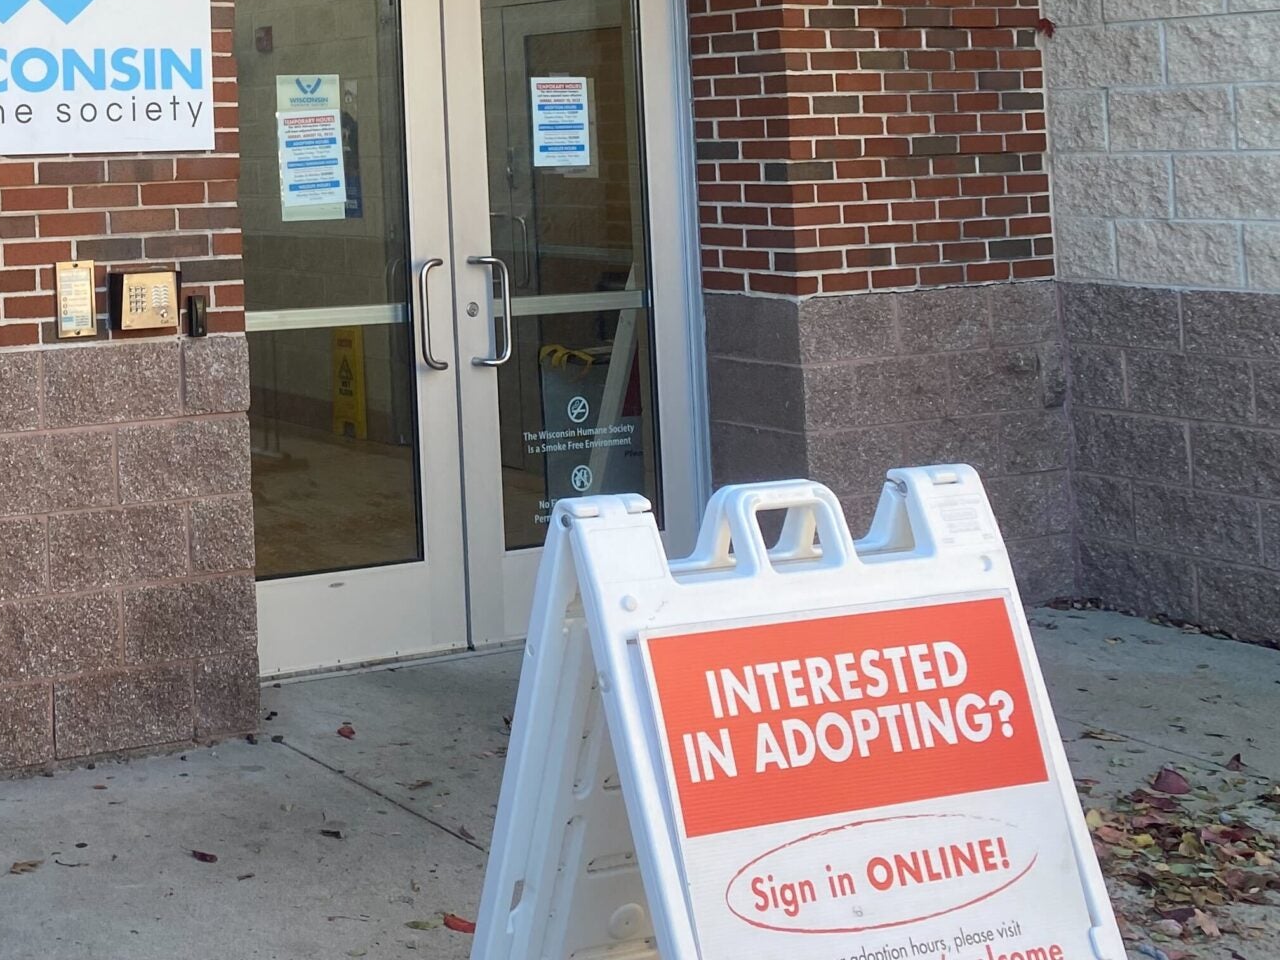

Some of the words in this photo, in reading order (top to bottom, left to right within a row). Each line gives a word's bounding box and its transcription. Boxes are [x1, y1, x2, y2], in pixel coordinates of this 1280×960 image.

[56, 95, 203, 127] society
[523, 431, 537, 442] The
[539, 428, 576, 440] Wisconsin
[577, 426, 608, 437] Humane
[609, 424, 635, 434] Society
[528, 445, 534, 454] Is
[541, 442, 566, 453] Smoke
[568, 440, 584, 451] Free
[585, 437, 632, 449] Environment
[539, 500, 551, 509] No
[705, 641, 968, 719] INTERESTED
[682, 728, 738, 783] IN
[756, 689, 1015, 774] ADOPTING?
[750, 873, 817, 918] Sign
[825, 864, 857, 899] in
[866, 836, 1011, 892] ONLINE!
[909, 936, 952, 957] hours,
[954, 927, 994, 954] please
[996, 919, 1022, 939] visit
